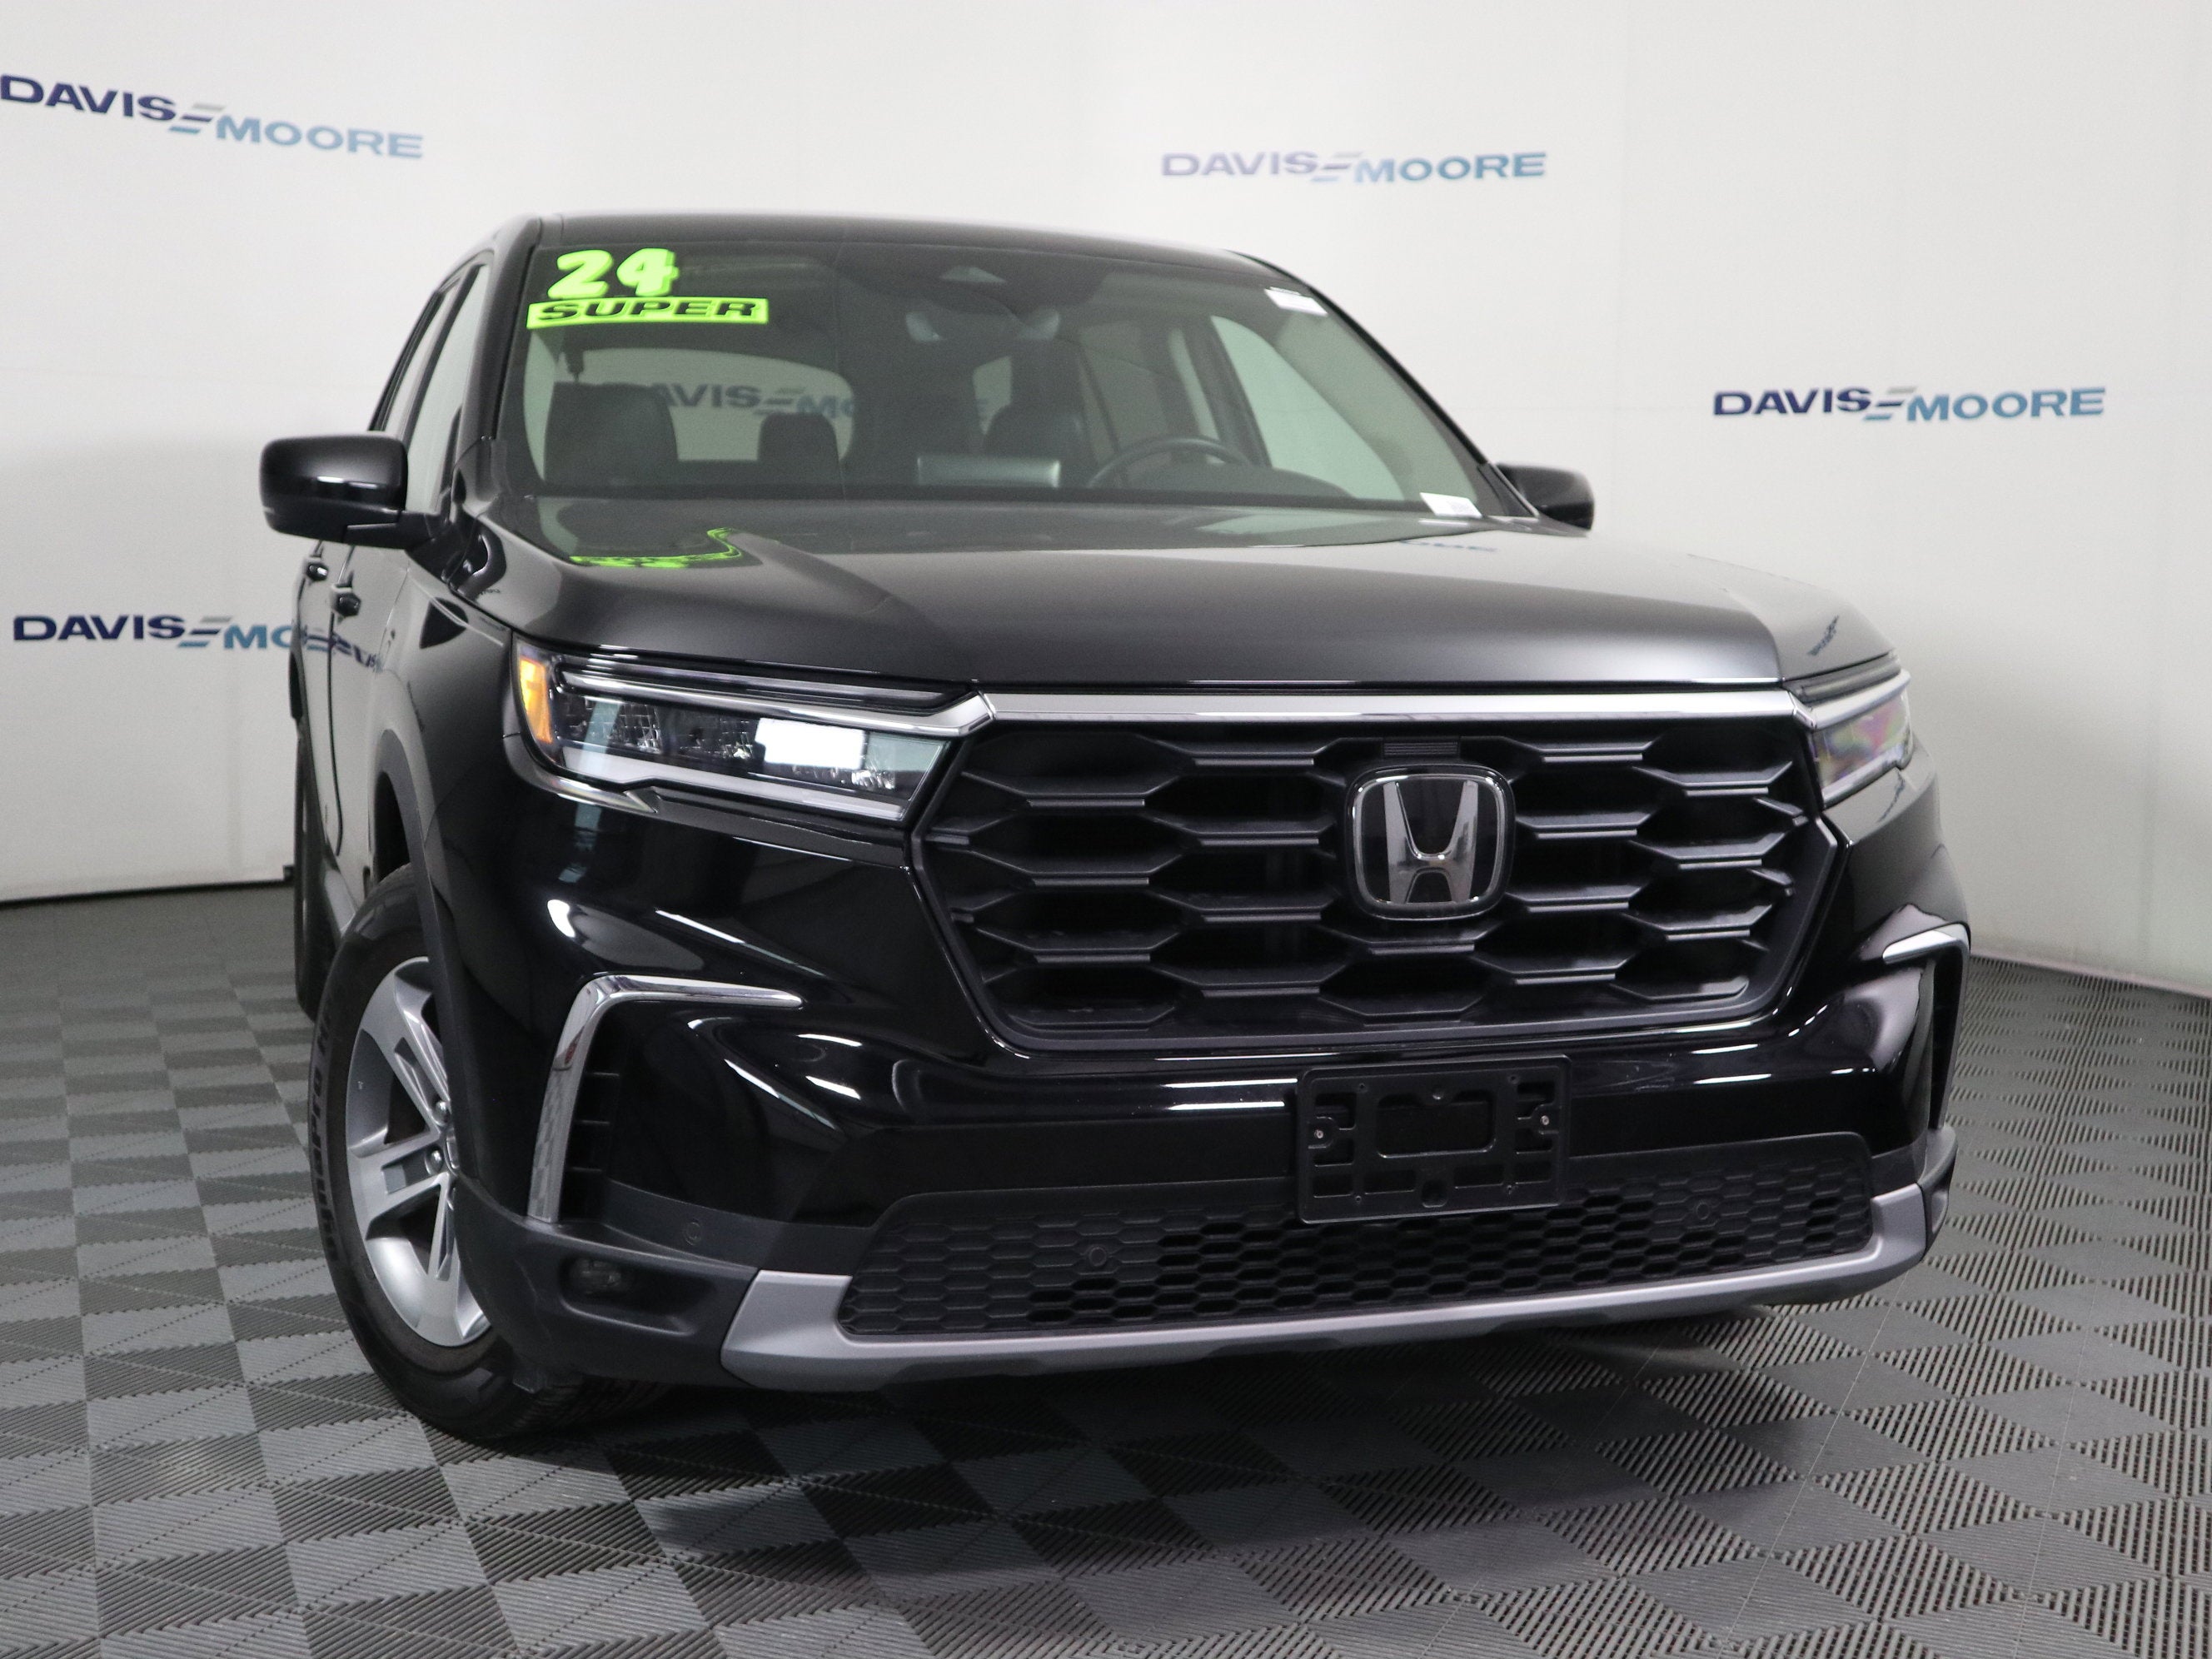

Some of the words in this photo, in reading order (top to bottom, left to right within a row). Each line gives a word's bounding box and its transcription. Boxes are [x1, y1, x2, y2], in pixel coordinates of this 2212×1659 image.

[0, 72, 177, 122] DAVIS
[216, 114, 423, 159] MOORE
[1161, 152, 1318, 177] DAVIS
[1354, 152, 1549, 183] MOORE
[547, 247, 680, 299] 24
[536, 298, 759, 321] SUPER
[650, 383, 760, 409] AVIS
[1712, 387, 1873, 416] DAVIS
[1906, 387, 2107, 422] MOORE
[12, 614, 187, 643] DAVIS
